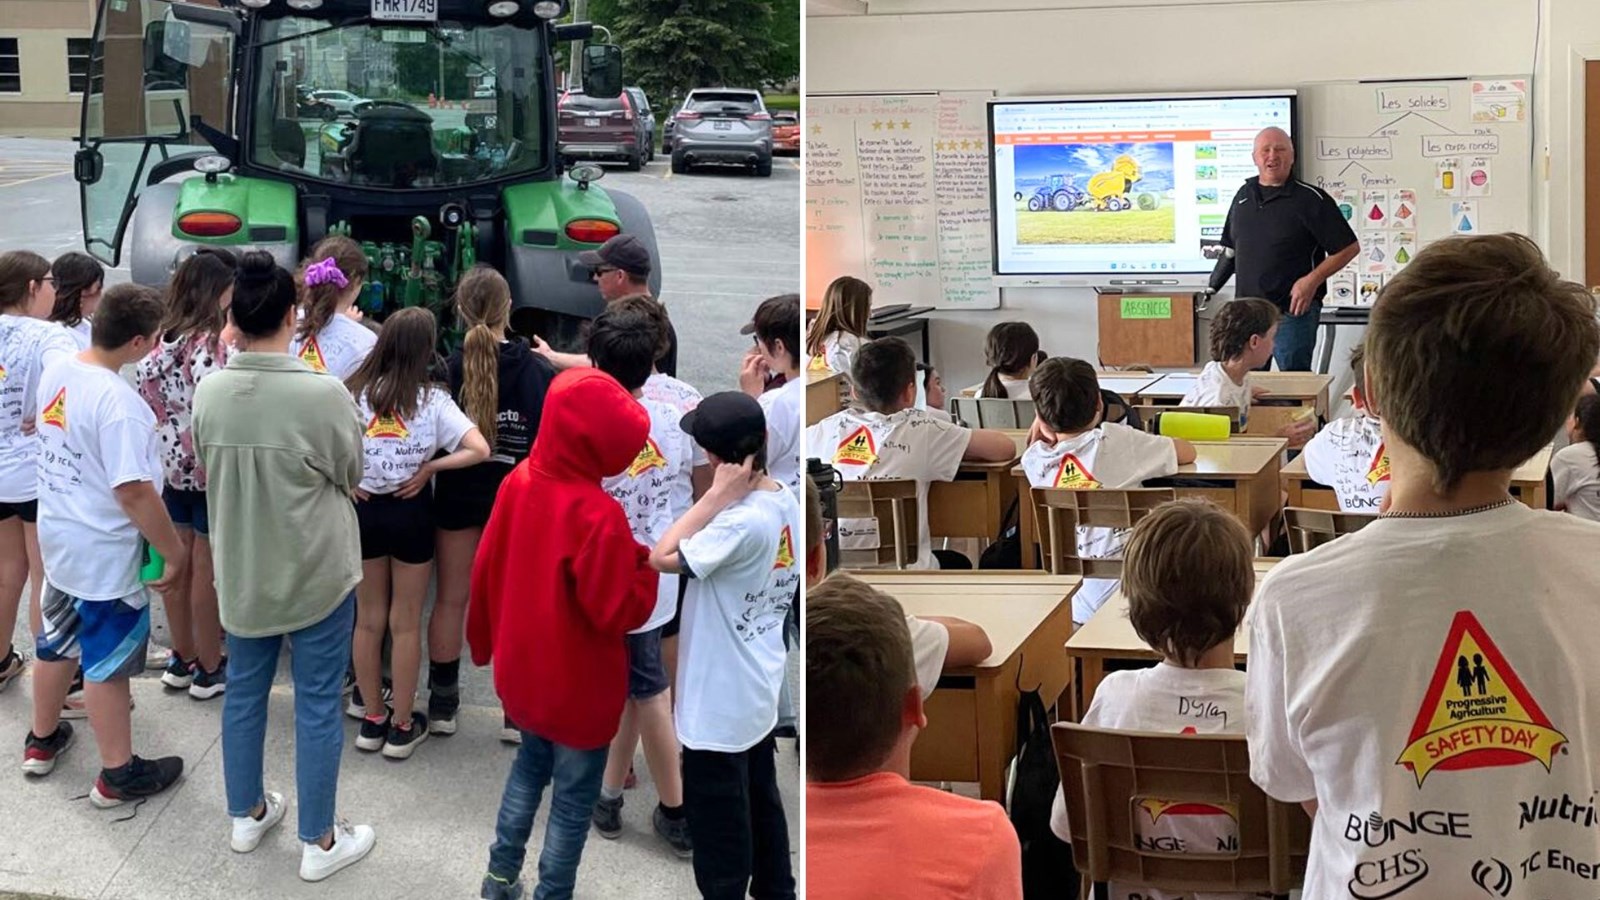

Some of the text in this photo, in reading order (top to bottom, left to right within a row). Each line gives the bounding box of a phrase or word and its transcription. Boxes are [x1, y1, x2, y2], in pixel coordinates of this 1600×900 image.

[1382, 92, 1447, 109] Les solides
[1321, 140, 1341, 156] Les
[1427, 140, 1441, 152] Les
[1469, 140, 1496, 151] ronds
[1123, 301, 1170, 316] ABSENCES
[1345, 495, 1384, 508] BUNG
[1446, 695, 1507, 710] Progressive
[1450, 705, 1506, 720] Agriculture
[1425, 726, 1540, 759] SAFETY DAY
[1345, 793, 1600, 847] BUNGE Nutri
[1135, 837, 1187, 851] NGE
[1354, 849, 1424, 887] CHS
[1520, 851, 1541, 879] TC
